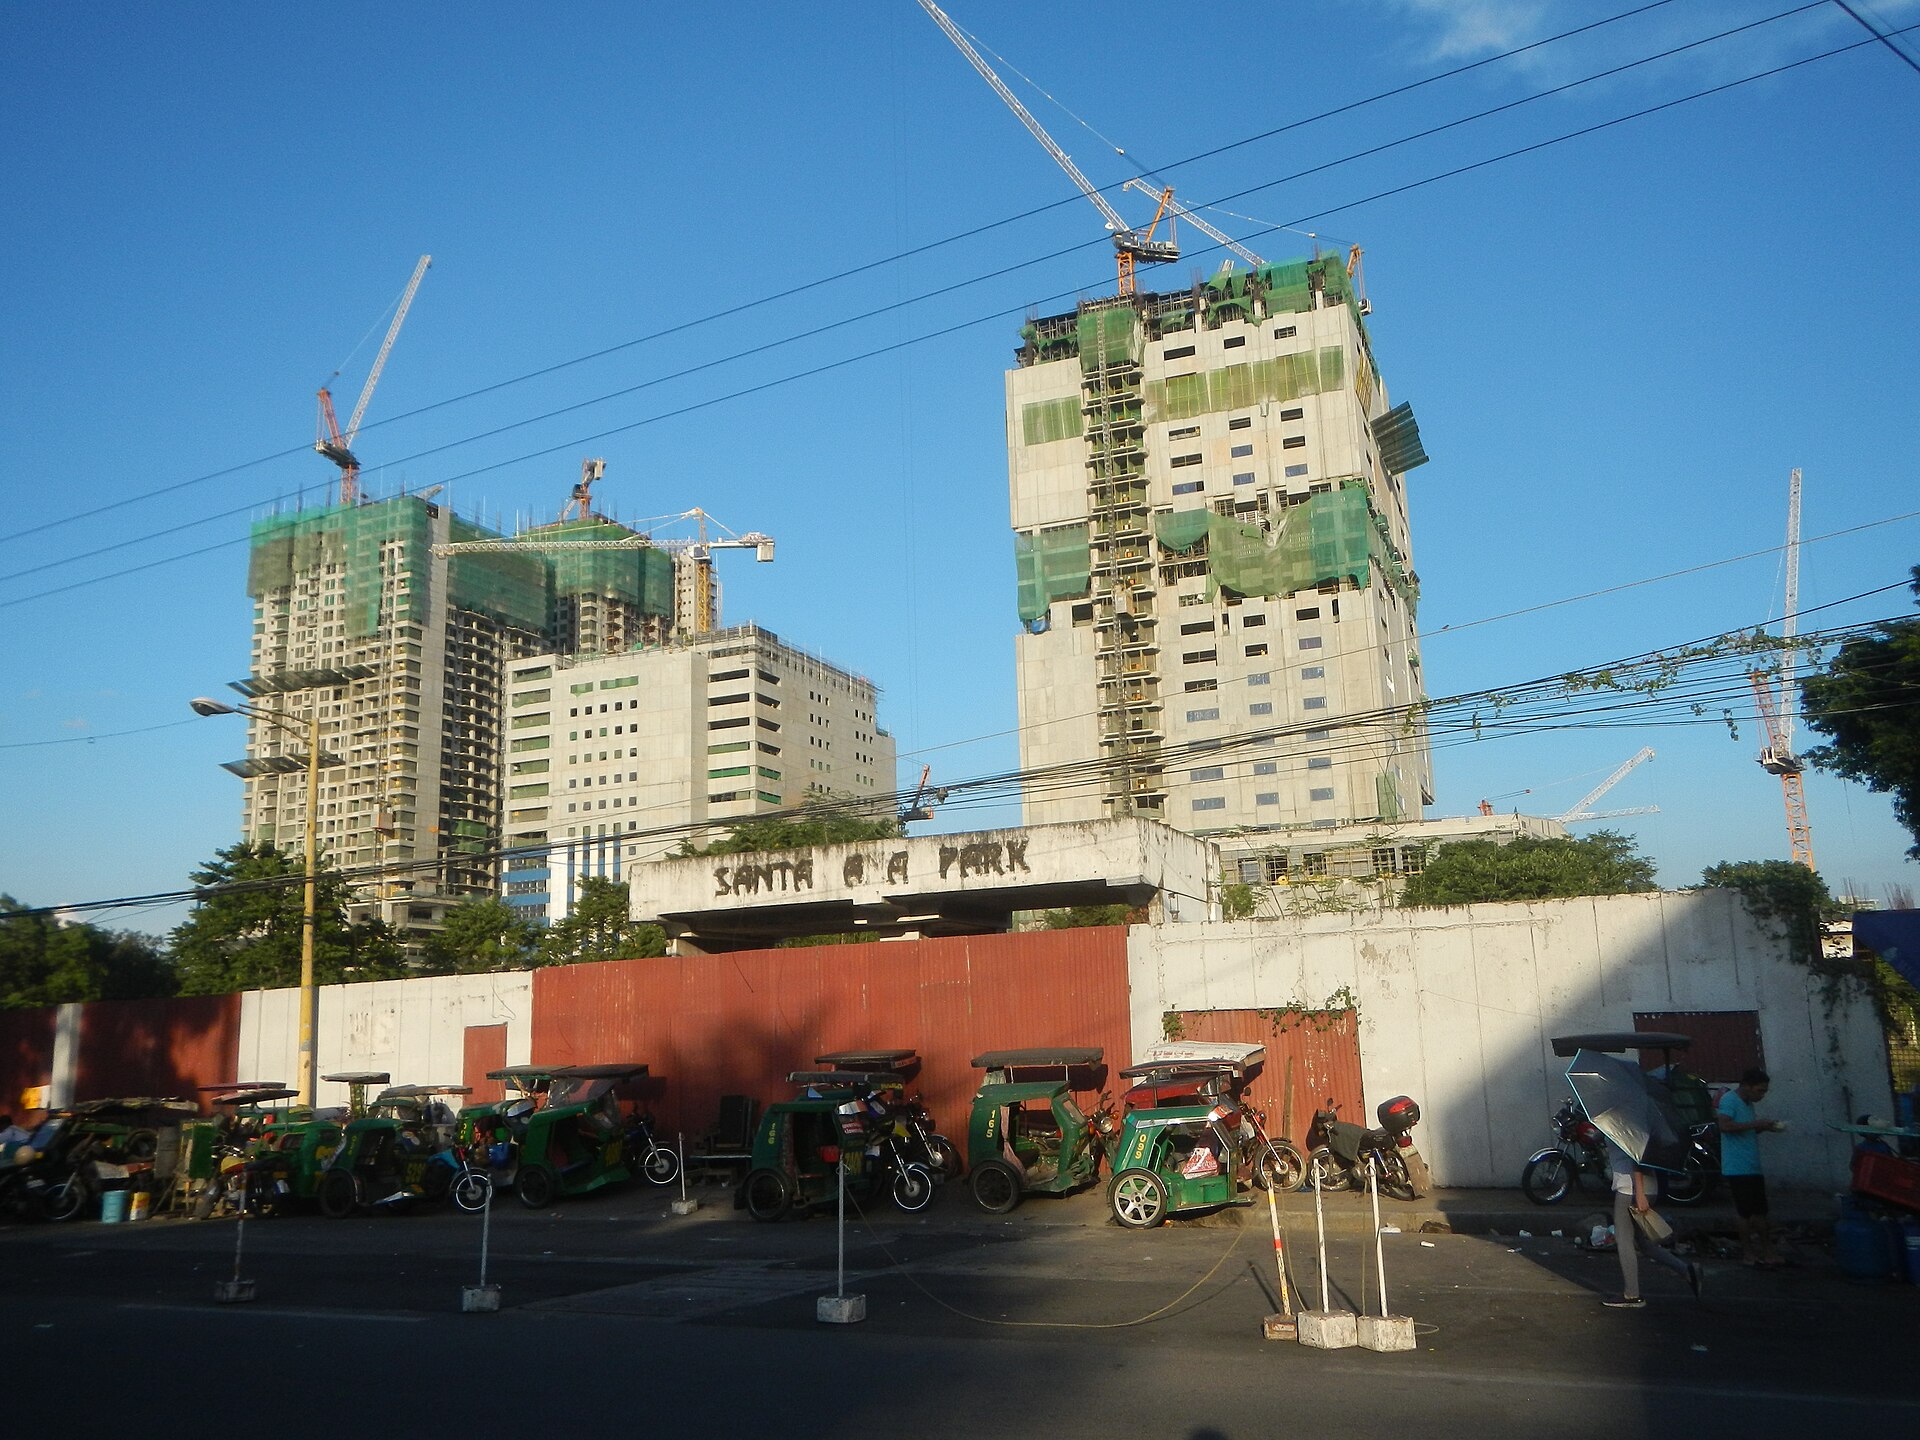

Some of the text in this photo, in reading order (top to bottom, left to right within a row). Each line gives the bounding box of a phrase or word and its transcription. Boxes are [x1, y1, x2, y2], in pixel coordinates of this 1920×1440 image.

[713, 859, 814, 897] SANTA
[939, 839, 1031, 879] PARK
[986, 1109, 996, 1138] 165
[1135, 1134, 1147, 1160] 099
